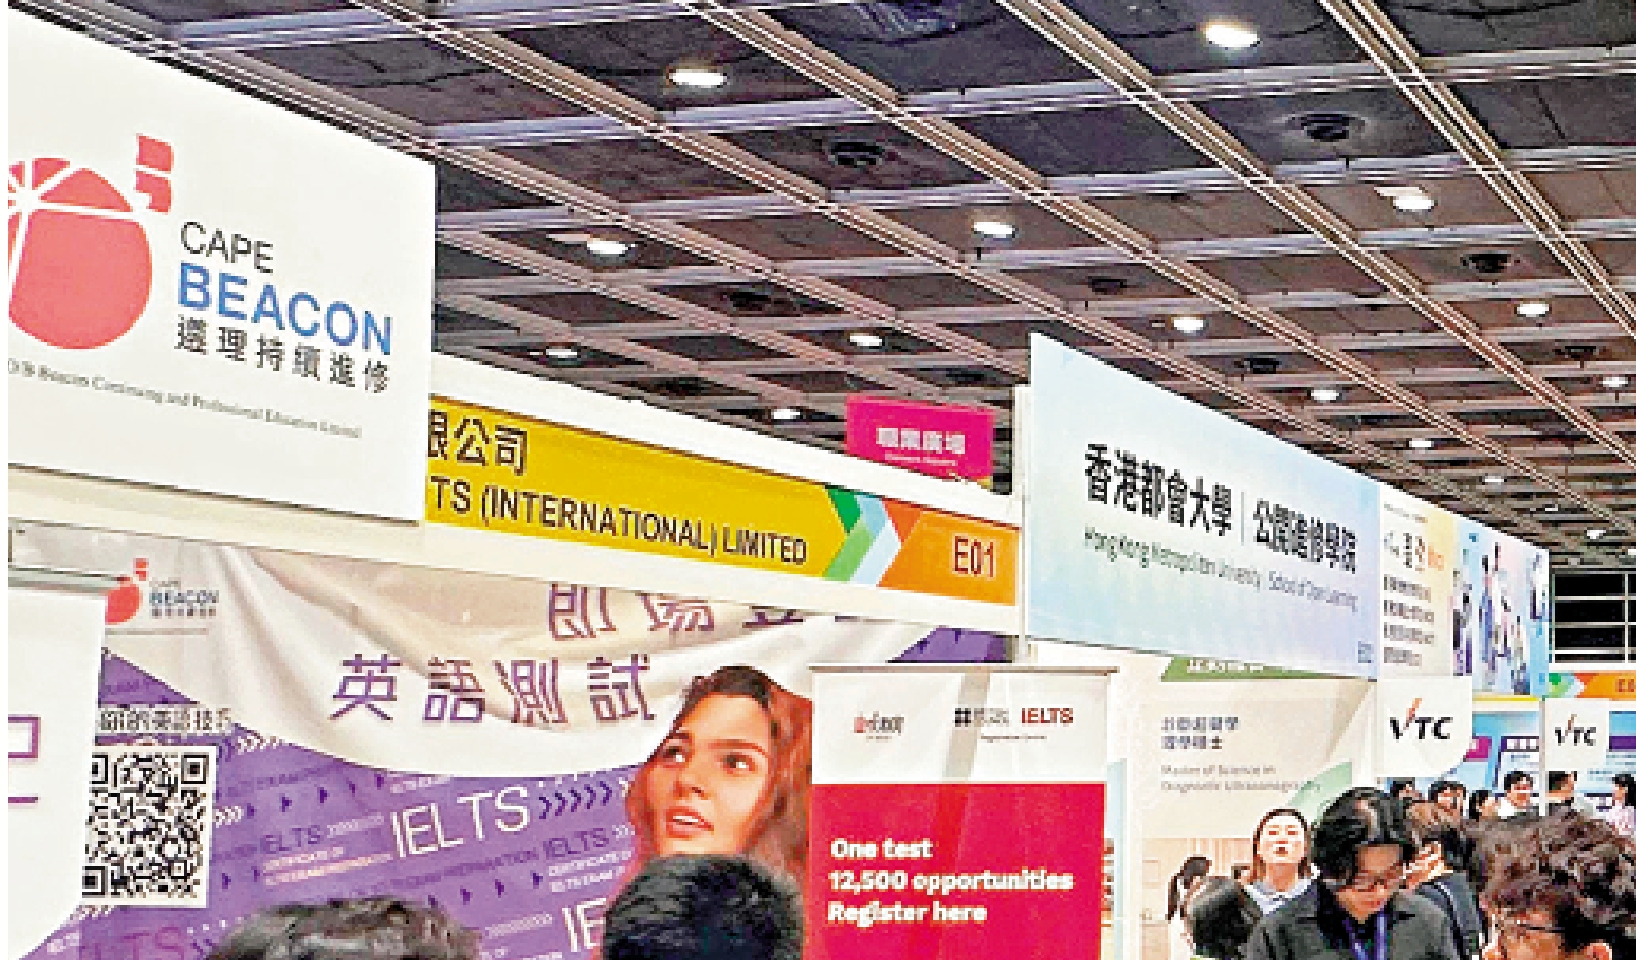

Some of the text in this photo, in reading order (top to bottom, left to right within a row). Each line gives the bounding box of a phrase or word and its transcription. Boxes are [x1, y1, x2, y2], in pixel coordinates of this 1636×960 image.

[180, 221, 274, 274] CAPE
[177, 261, 392, 356] BEACON
[1084, 442, 1234, 538] 香港都會大學
[430, 475, 808, 566] TS (INTERNATIONAL) LIMITED
[953, 534, 996, 579] E01
[1084, 526, 1118, 563] Hong
[1118, 533, 1150, 569] Kong
[1150, 543, 1217, 577] Metropolitan
[1217, 560, 1262, 592] University
[329, 652, 657, 725] 英語測試
[1021, 707, 1075, 725] IELTS
[1389, 697, 1453, 741] VTC
[1554, 713, 1598, 746] VTC
[391, 785, 531, 859] IELTS
[543, 827, 610, 859] IELTS
[830, 837, 934, 859] One test
[828, 868, 1074, 896] 12,500 opportunities
[827, 900, 988, 928] Register here
